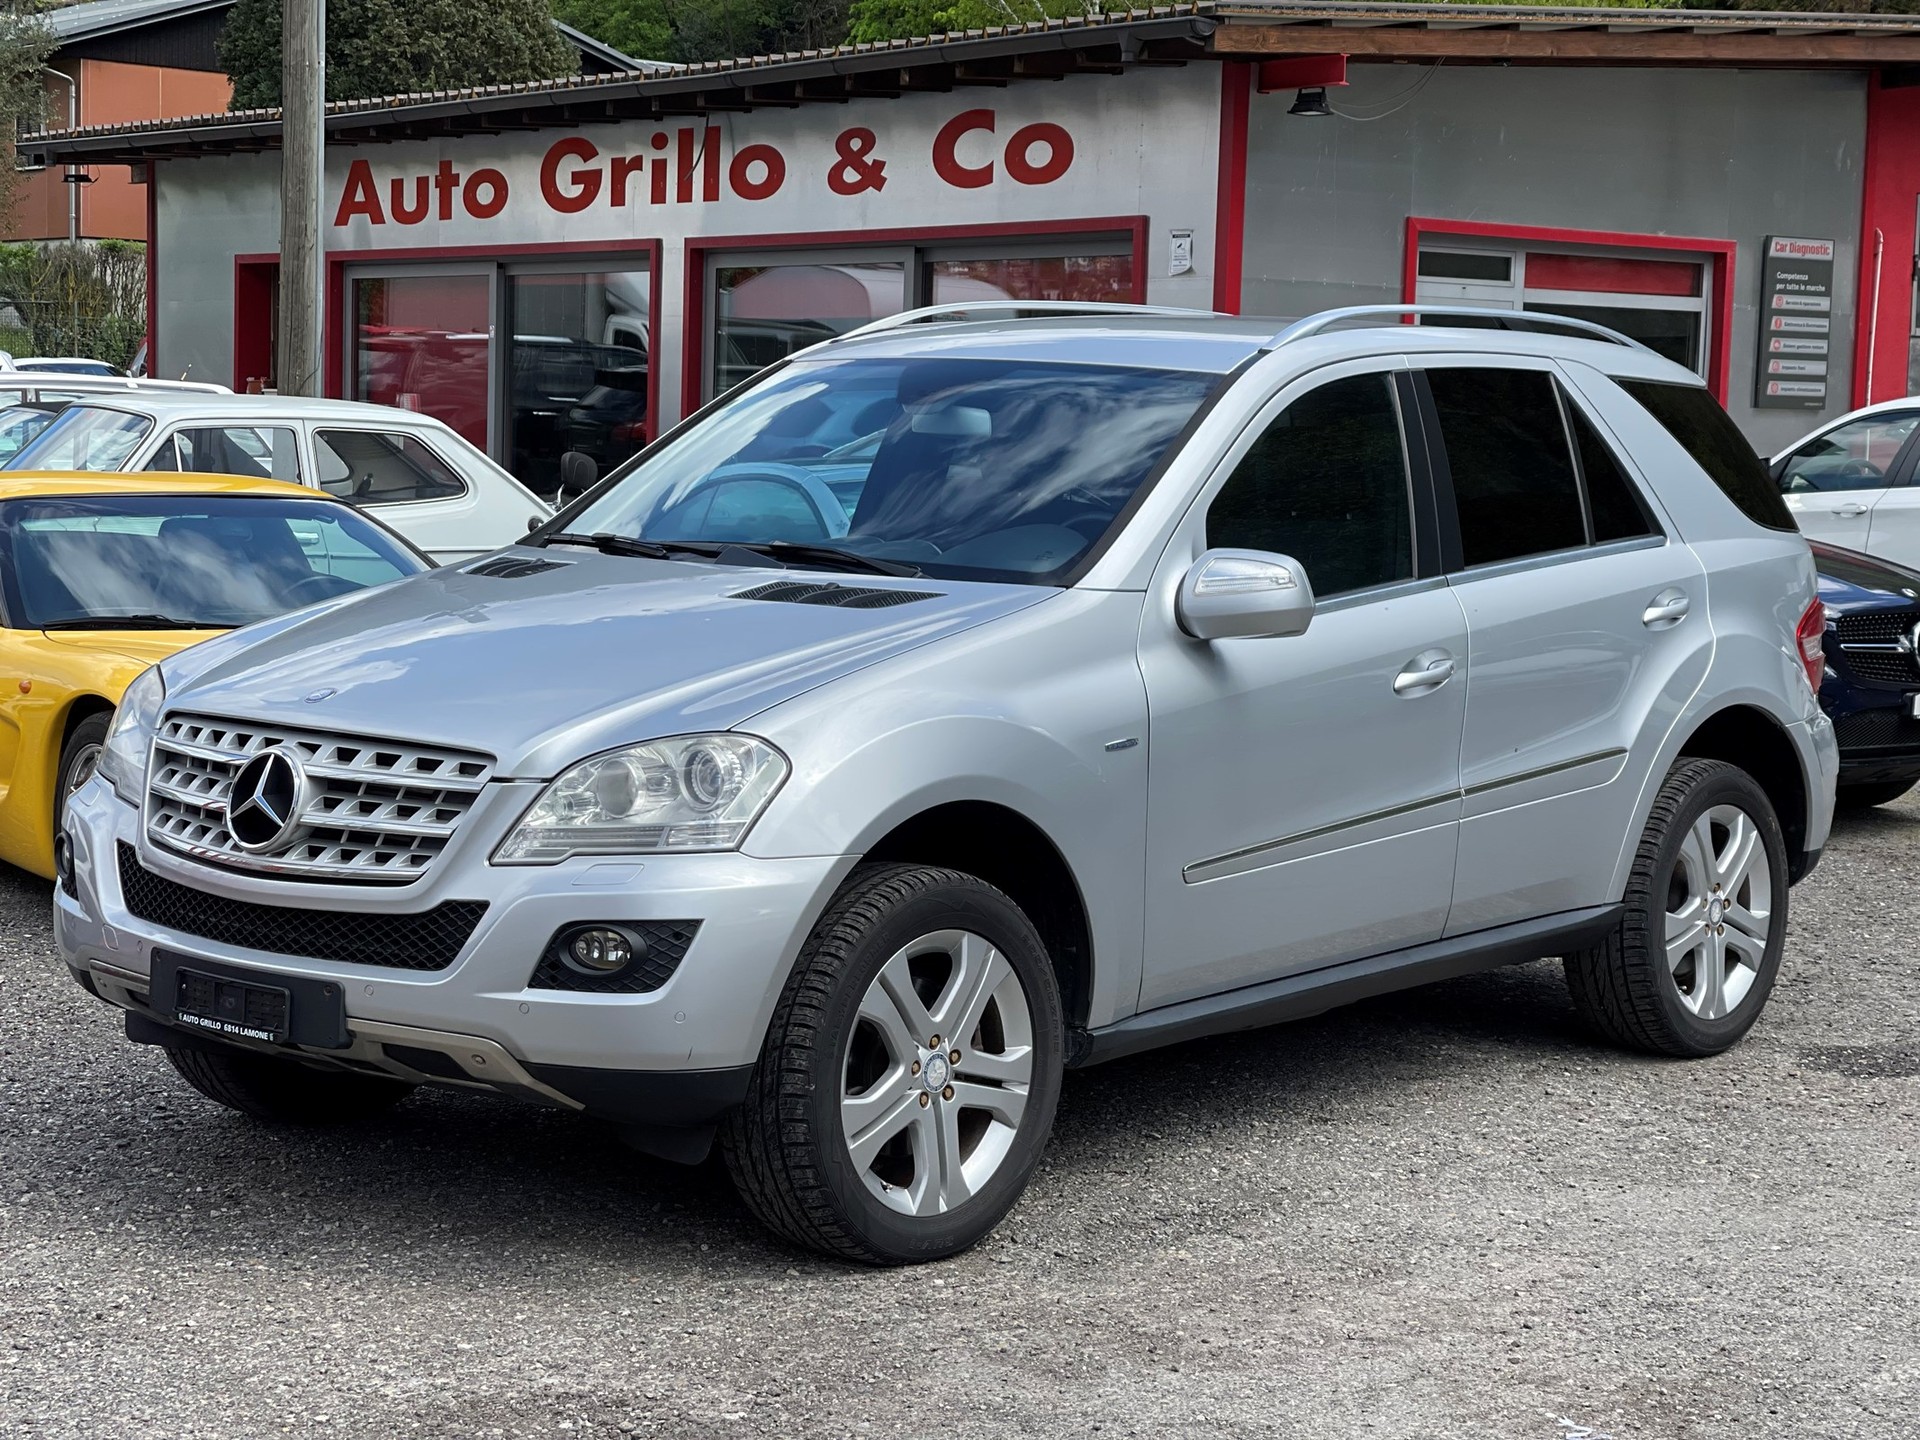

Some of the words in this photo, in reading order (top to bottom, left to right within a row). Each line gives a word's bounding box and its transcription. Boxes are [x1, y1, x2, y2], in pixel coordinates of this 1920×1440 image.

[334, 160, 509, 226] Auto
[540, 125, 786, 214] Grillo
[827, 127, 888, 196] &
[932, 108, 1075, 189] Co
[1775, 241, 1788, 253] Car
[1789, 242, 1830, 257] Diagnostic
[1776, 271, 1808, 280] Competenza
[1776, 283, 1786, 291] per
[1786, 283, 1800, 291] tutte
[1806, 284, 1826, 292] marche
[182, 1014, 199, 1024] AUTO
[200, 1018, 221, 1030] GRILLO
[223, 1023, 239, 1034] 6814
[240, 1027, 268, 1040] LAMONE
